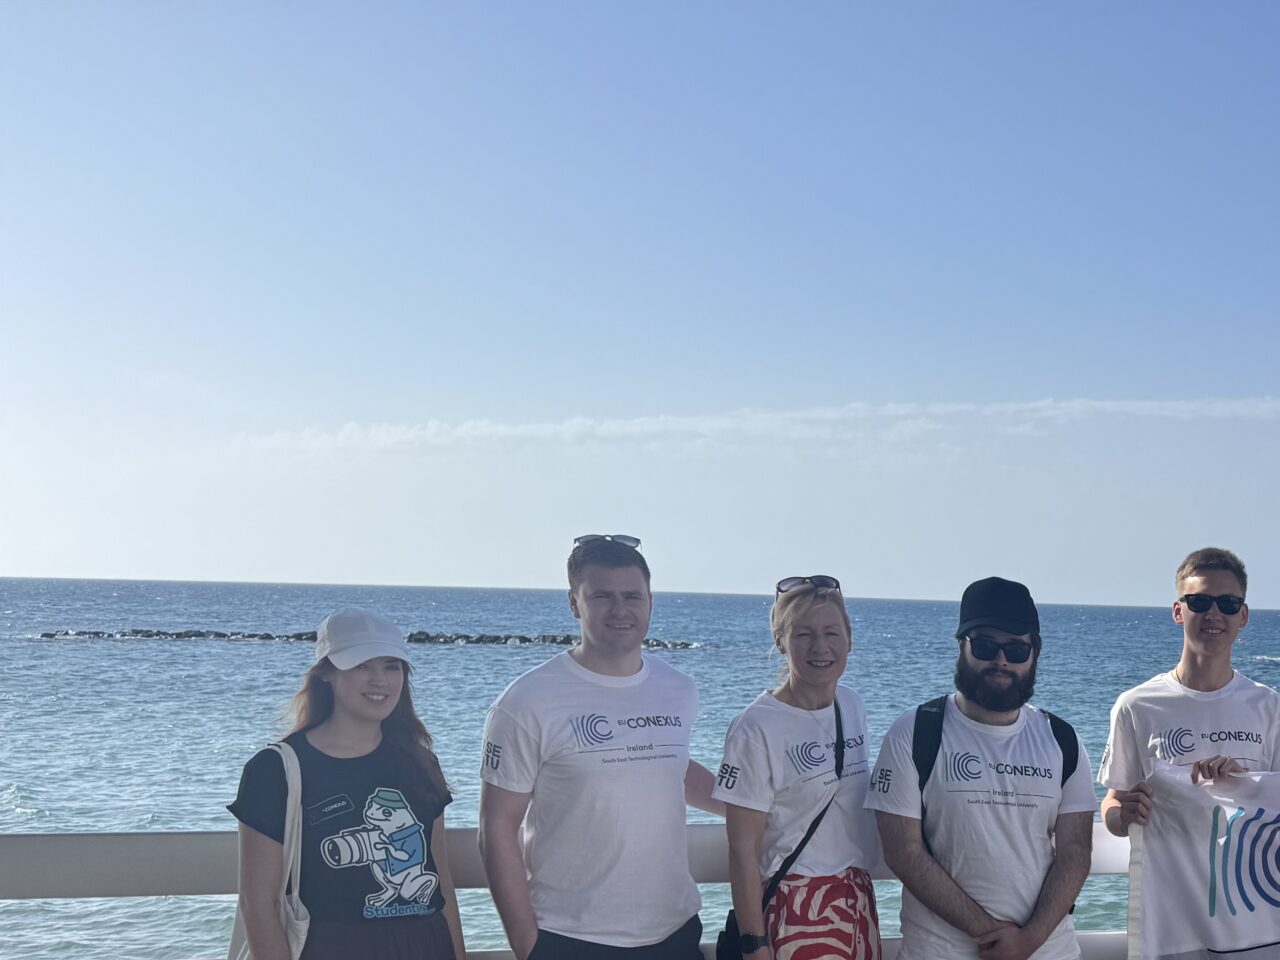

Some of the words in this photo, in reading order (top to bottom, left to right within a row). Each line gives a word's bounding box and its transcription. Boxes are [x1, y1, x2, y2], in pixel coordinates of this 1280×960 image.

[486, 741, 502, 758] SE
[626, 744, 654, 752] Ireland
[720, 763, 740, 779] SE
[879, 768, 892, 781] SE
[718, 774, 736, 790] TU
[878, 780, 891, 793] TU
